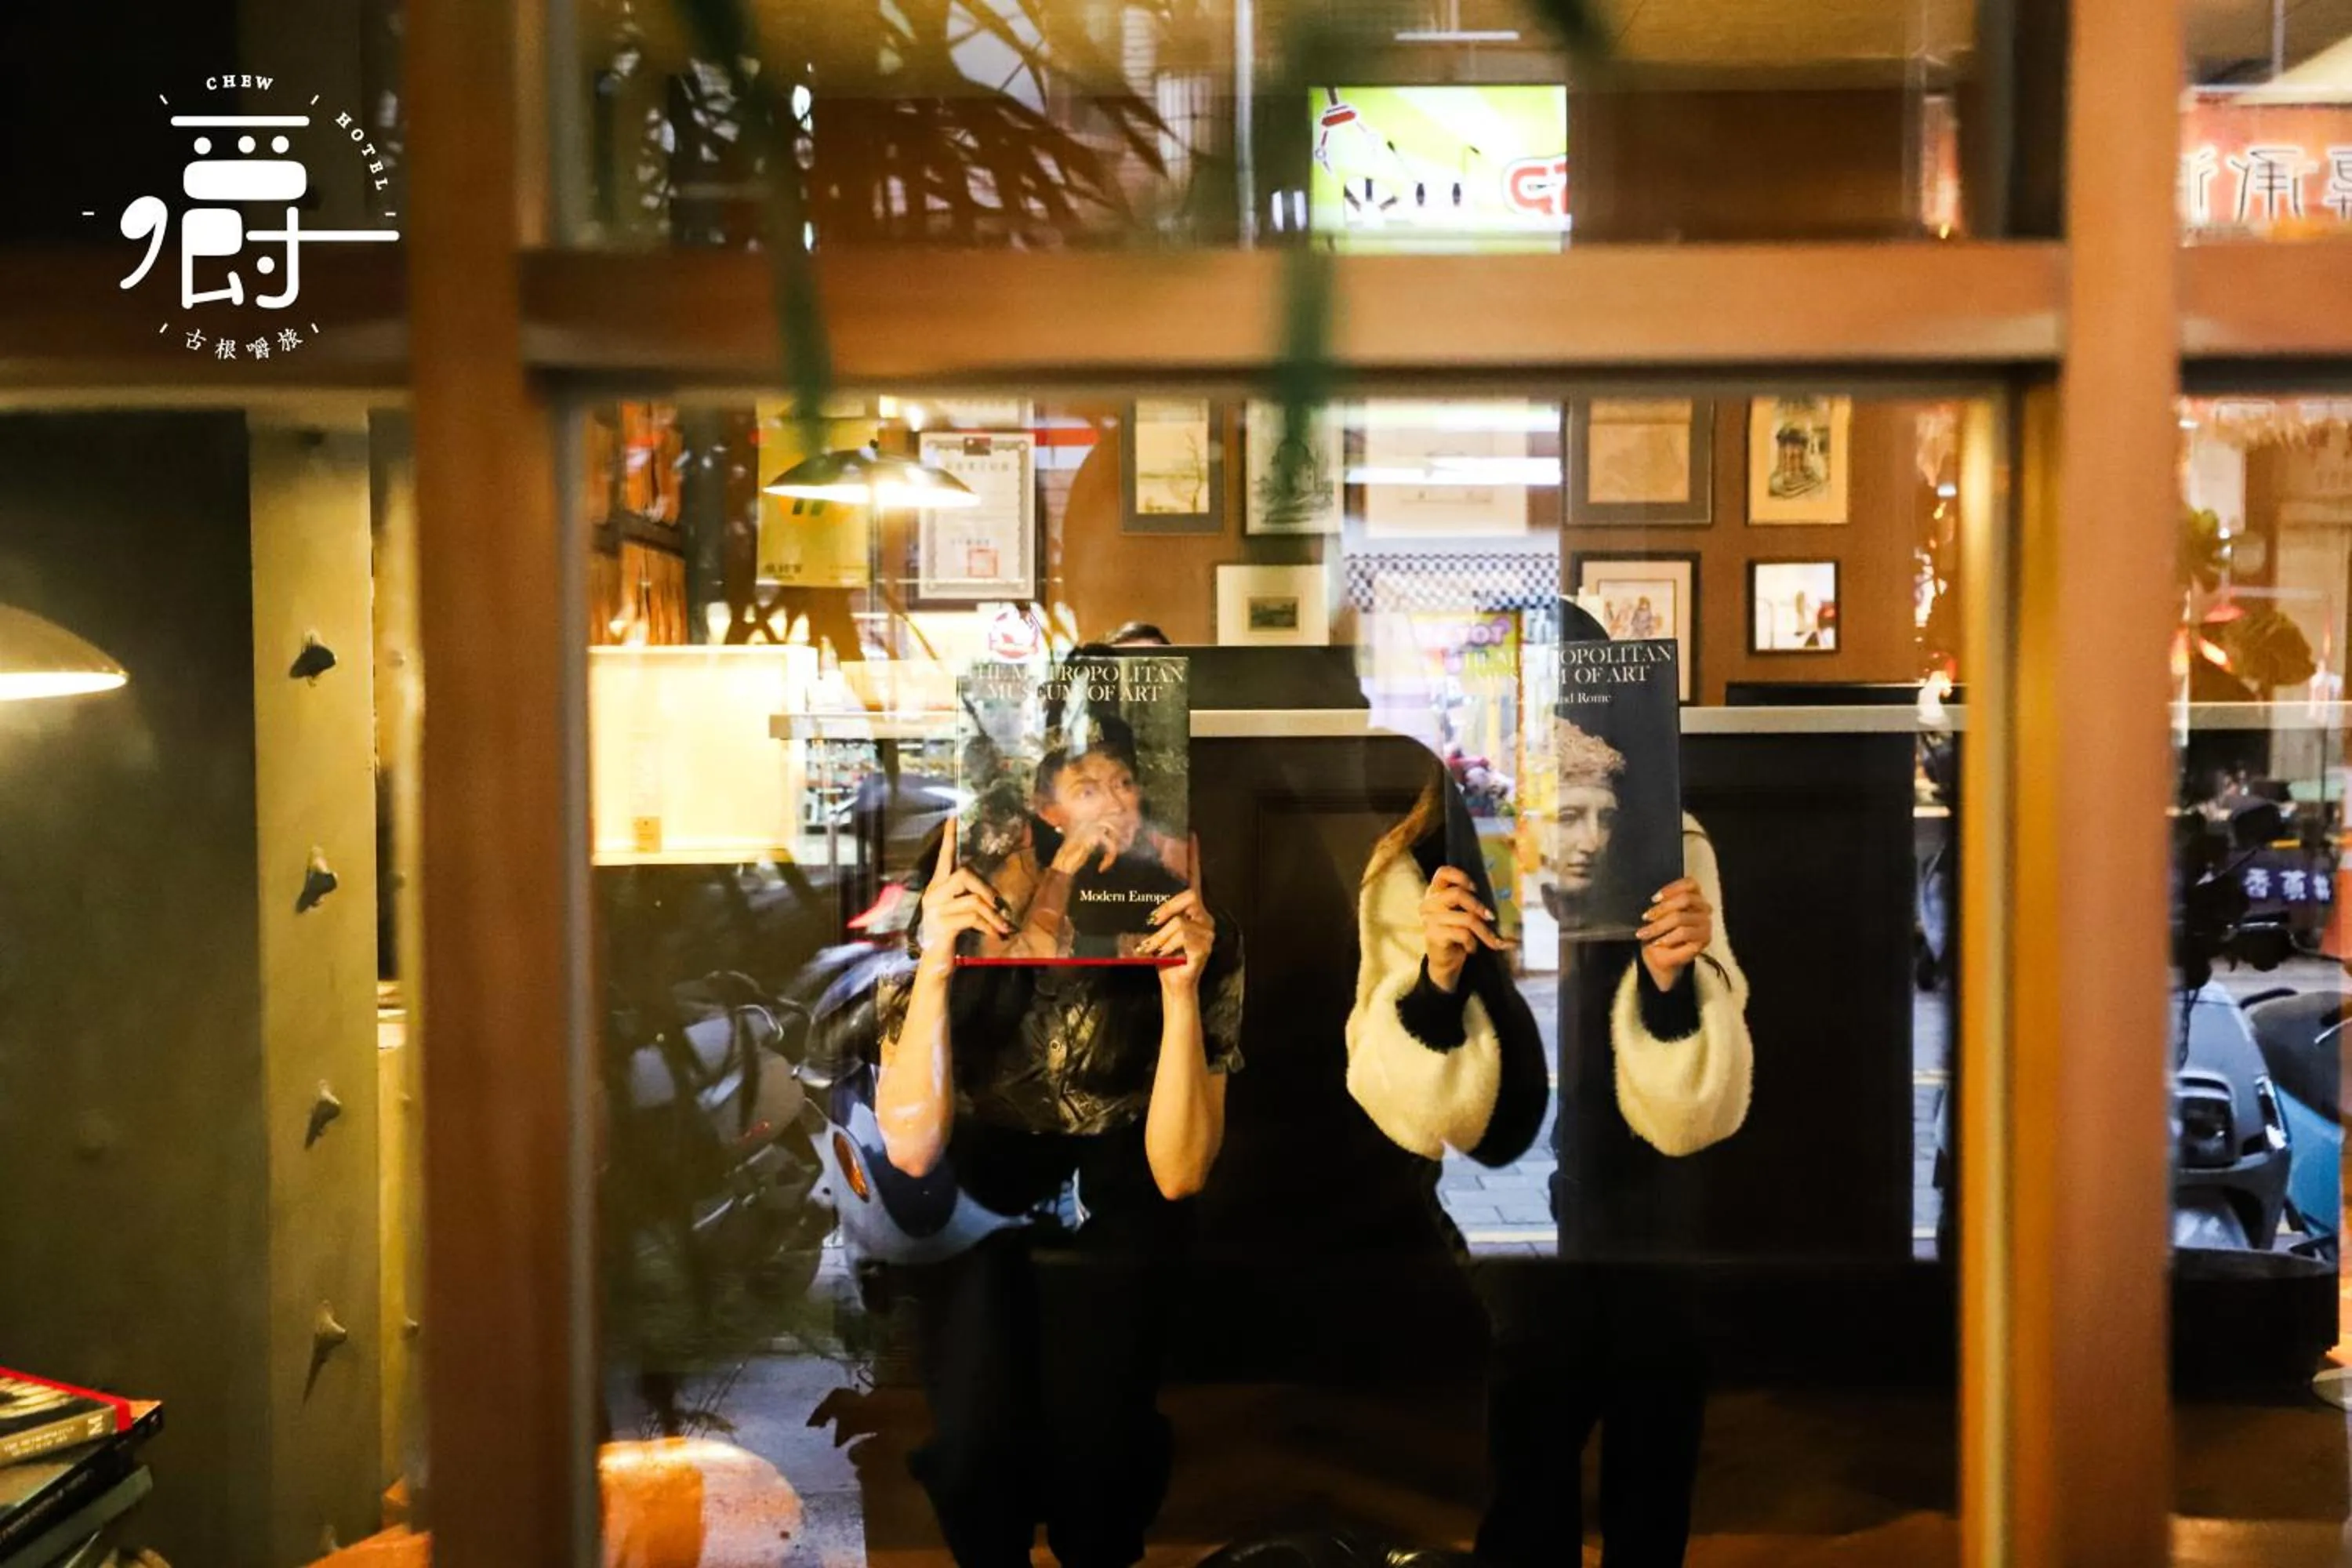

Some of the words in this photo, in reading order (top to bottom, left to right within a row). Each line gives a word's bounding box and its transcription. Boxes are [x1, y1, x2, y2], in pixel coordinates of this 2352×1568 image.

[1573, 666, 1604, 684] OF
[1606, 665, 1650, 683] ART
[1087, 684, 1116, 702] OF
[1119, 684, 1163, 702] ART
[1577, 692, 1612, 704] Rome
[1079, 890, 1126, 902] Modern
